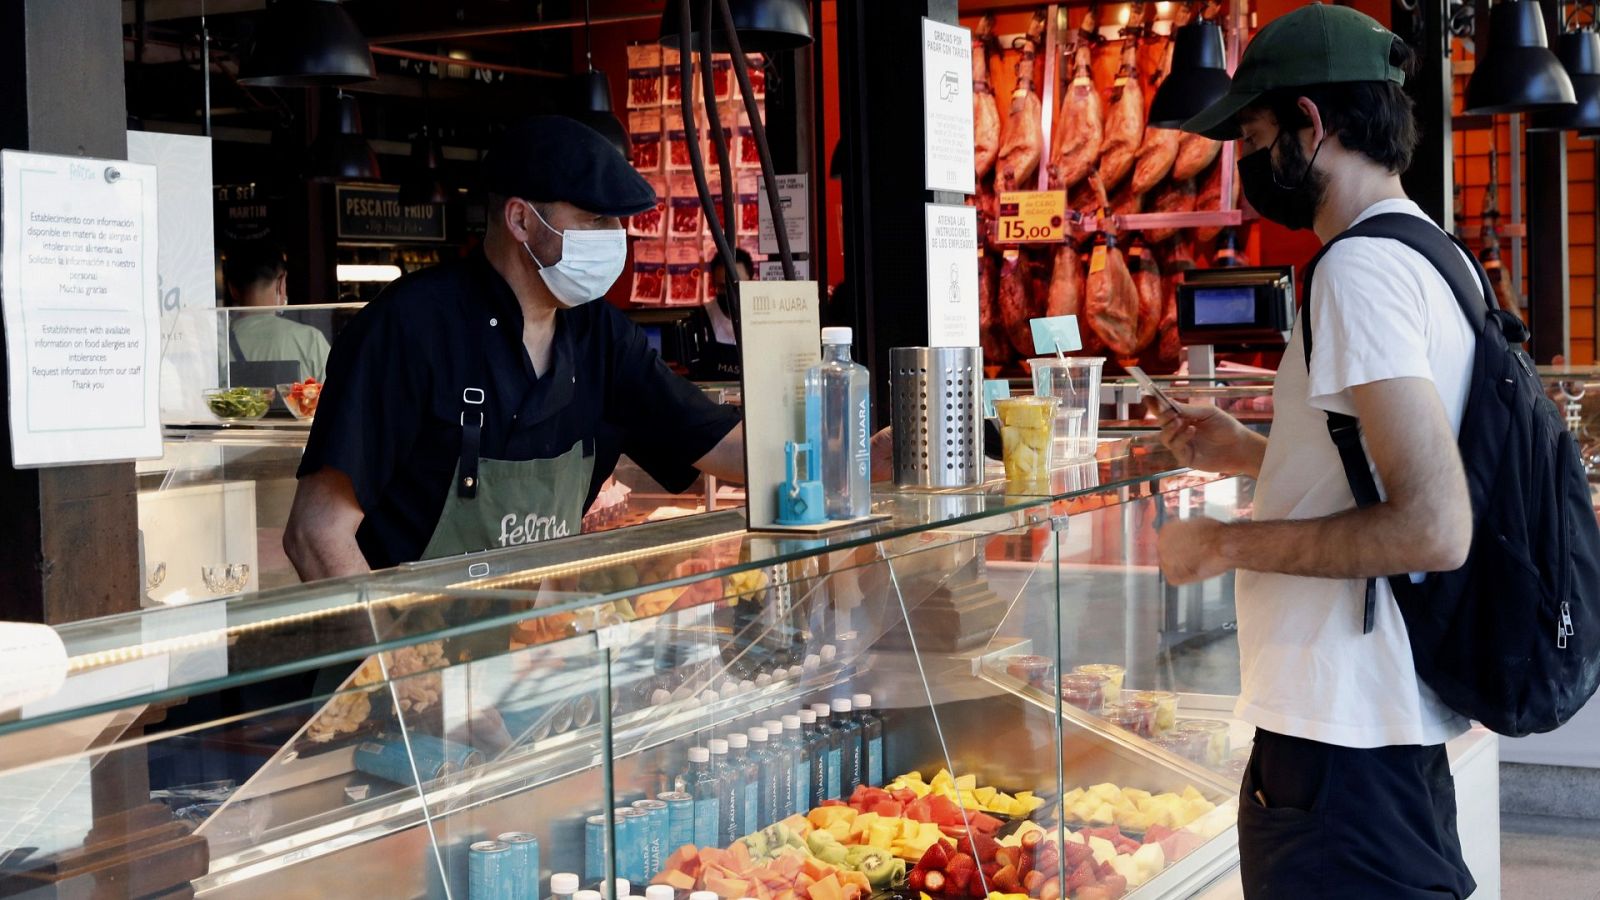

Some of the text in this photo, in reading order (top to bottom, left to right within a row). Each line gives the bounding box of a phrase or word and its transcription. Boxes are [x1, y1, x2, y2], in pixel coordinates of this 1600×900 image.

[30, 212, 135, 228] Establecimiento con información
[27, 227, 61, 238] disponible
[1004, 220, 1051, 241] 15,00
[779, 297, 808, 312] AUARA
[42, 324, 131, 335] Establishment with available
[34, 338, 73, 348] information
[84, 338, 100, 348] food
[68, 353, 107, 362] intolerances
[32, 366, 59, 377] Request
[60, 366, 98, 376] information
[98, 366, 115, 375] from
[72, 380, 105, 392] Thank you
[858, 399, 866, 448] AUARA
[652, 838, 660, 872] AUARA
